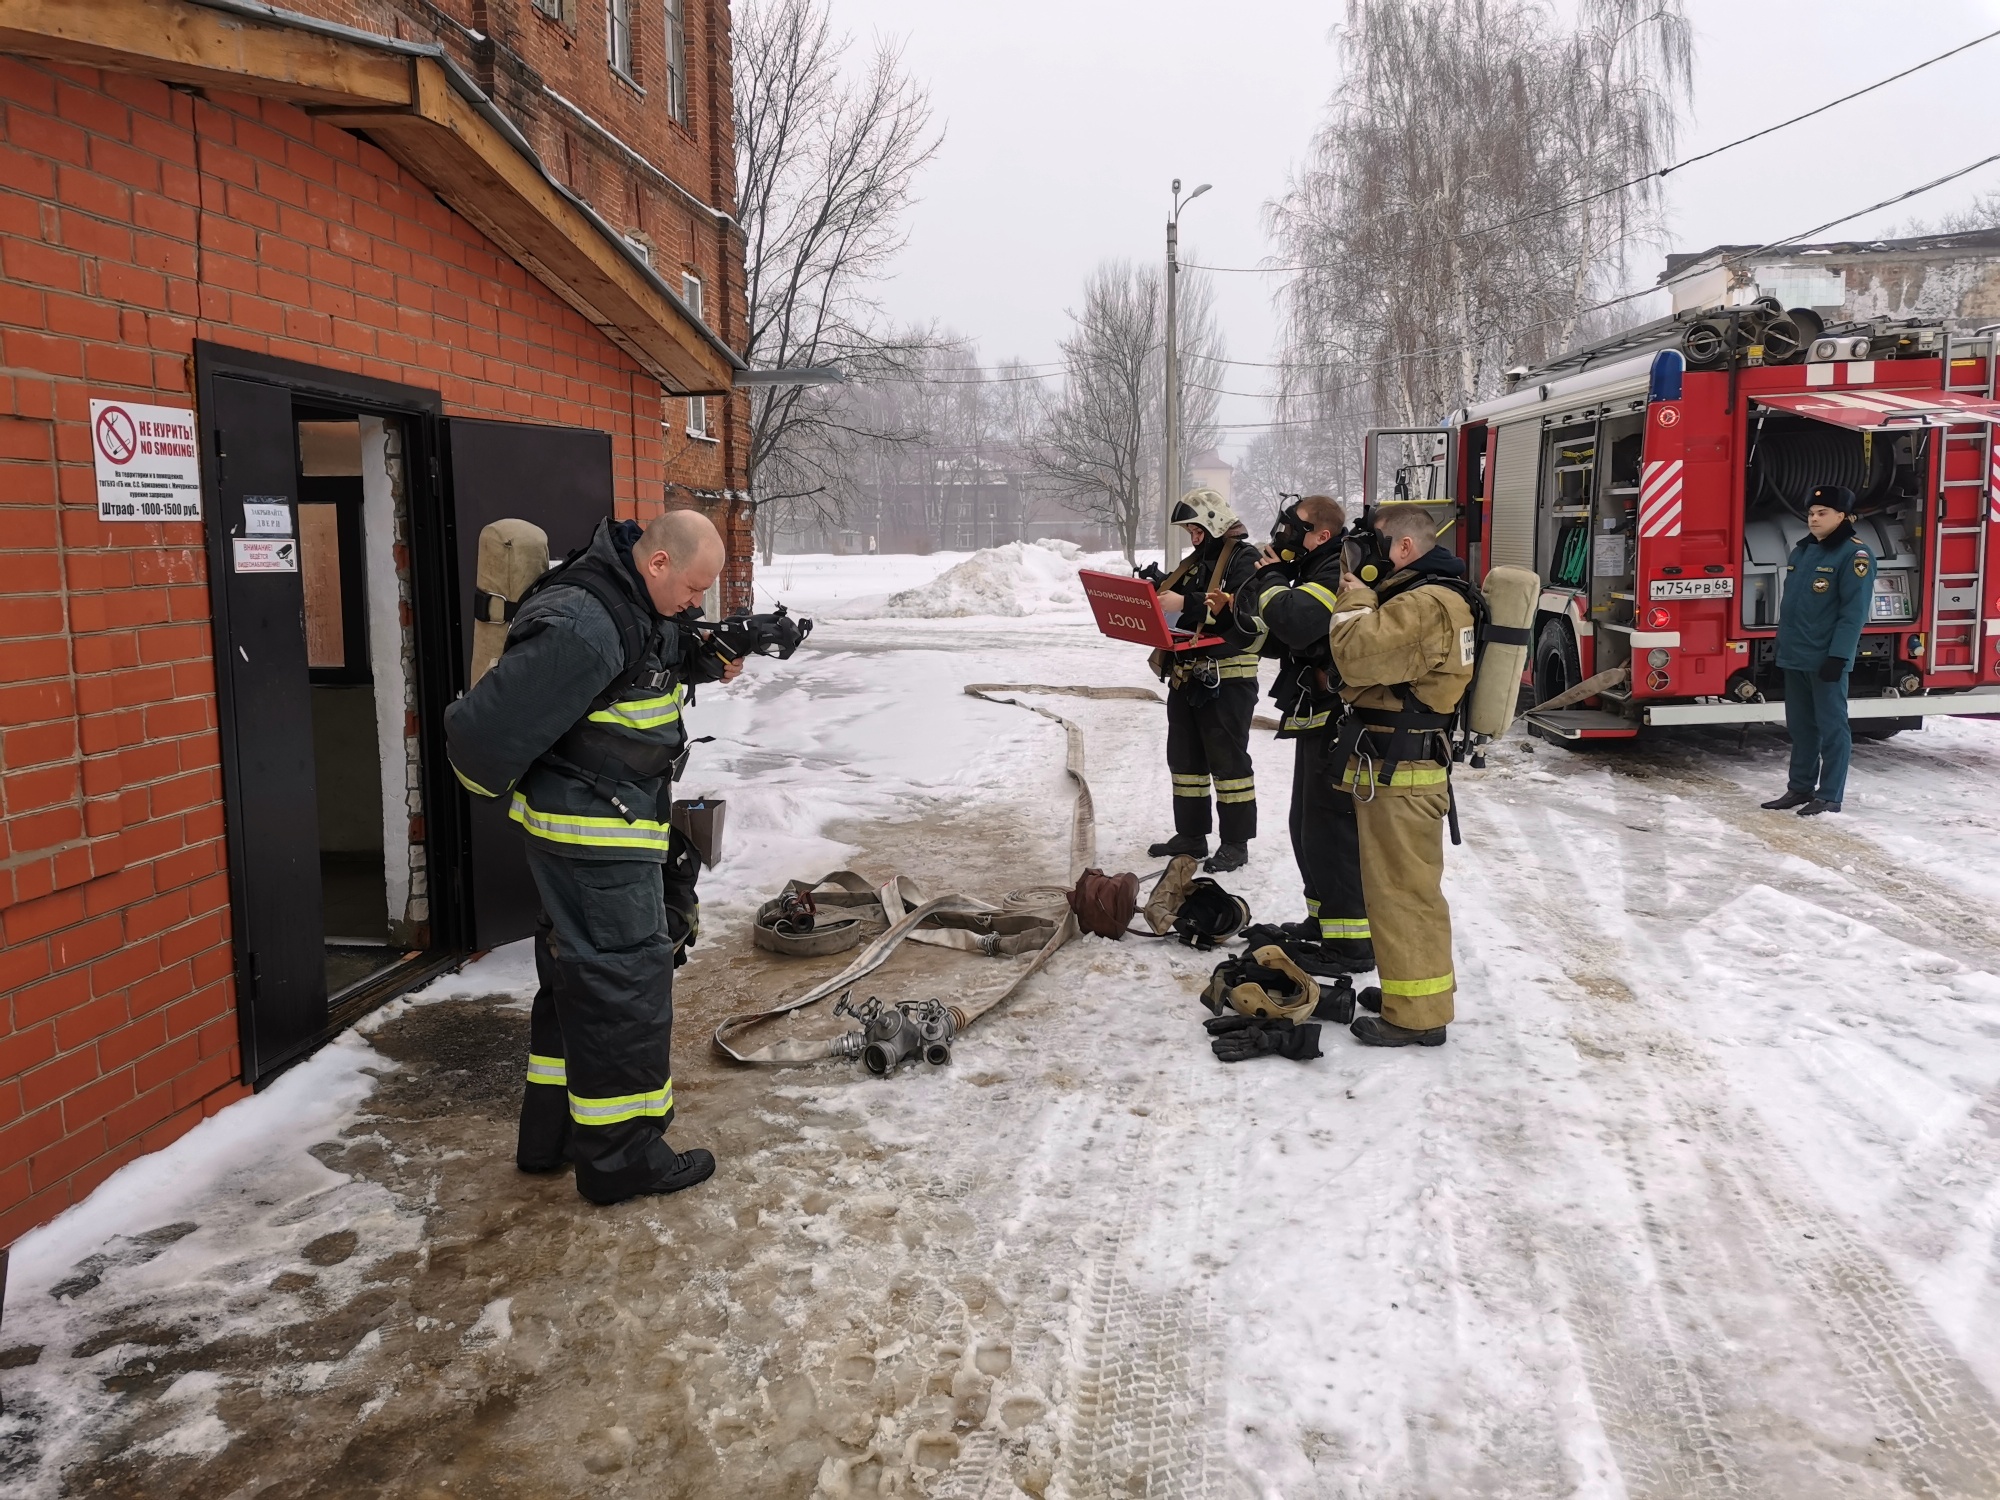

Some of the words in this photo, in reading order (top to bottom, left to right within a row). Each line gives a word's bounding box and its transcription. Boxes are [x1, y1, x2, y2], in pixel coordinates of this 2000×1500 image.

[139, 421, 152, 437] НЕ
[153, 423, 194, 441] КУРИТЬ!
[141, 441, 153, 455] NO
[155, 442, 195, 458] SMOKING!
[115, 470, 122, 478] На
[122, 471, 149, 479] территории
[102, 502, 135, 516] Штраф
[141, 502, 182, 516] 1000-1500
[183, 503, 200, 517] руб.
[251, 508, 283, 517] ЗАКРЫВАЙТЕ
[244, 543, 273, 551] ВНИМАНИЕ!
[1714, 579, 1728, 590] 68
[1087, 588, 1152, 608] безопасности
[1108, 612, 1147, 632] ПОСТ
